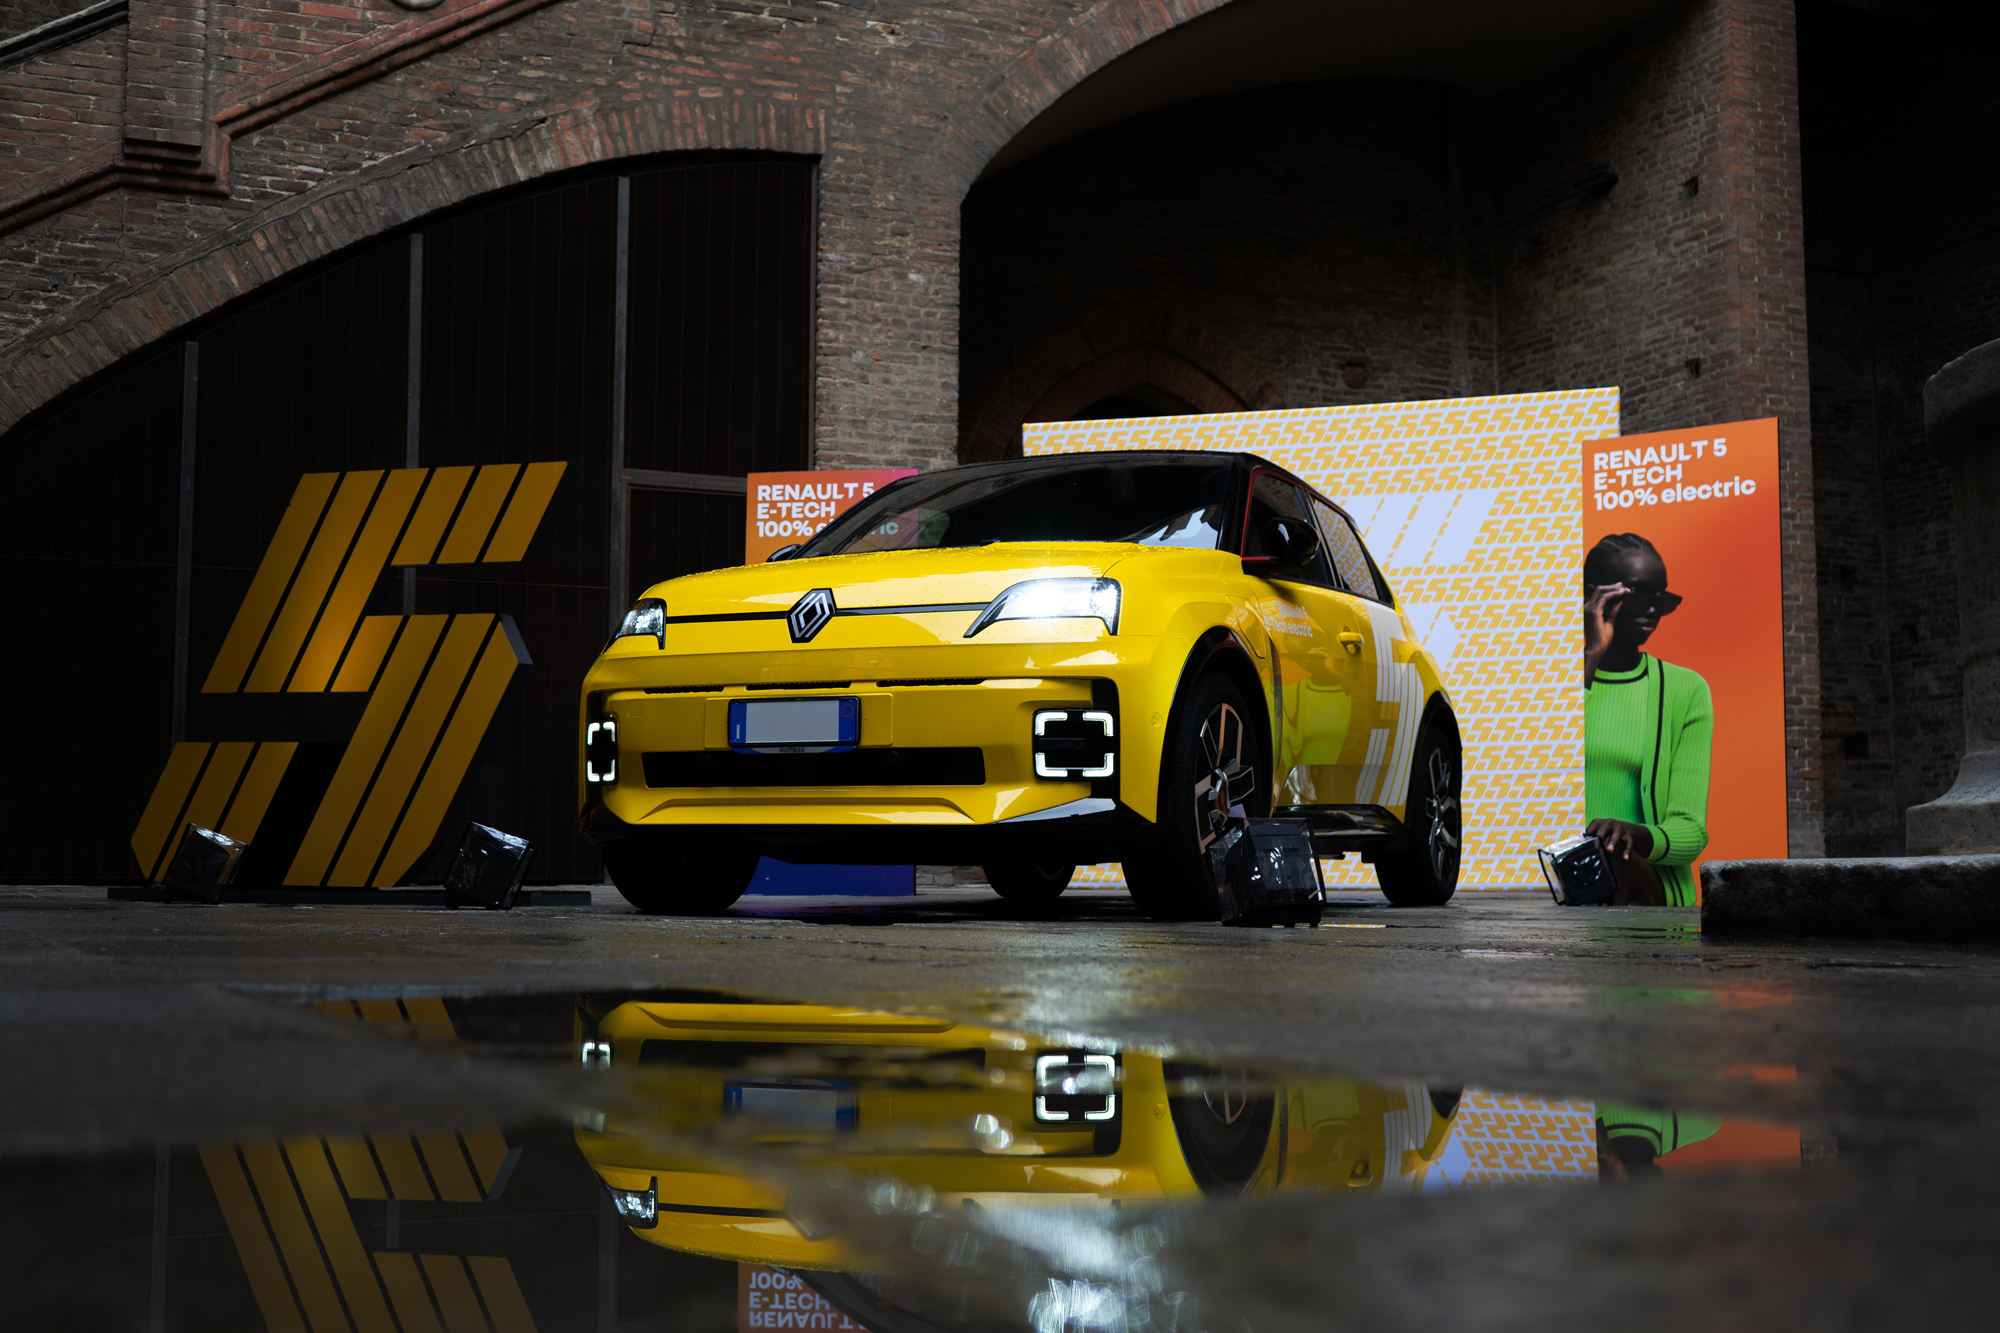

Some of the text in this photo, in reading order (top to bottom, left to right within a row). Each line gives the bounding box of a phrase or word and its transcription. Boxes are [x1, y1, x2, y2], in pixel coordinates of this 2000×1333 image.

[1594, 438, 1727, 471] RENAULT 5
[1594, 463, 1682, 491] E-TECH
[757, 482, 875, 501] RENAULT 5
[1594, 476, 1757, 511] 100% electric
[757, 501, 836, 519] E-TECH
[756, 520, 814, 537] 100%
[1288, 619, 1313, 638] electric
